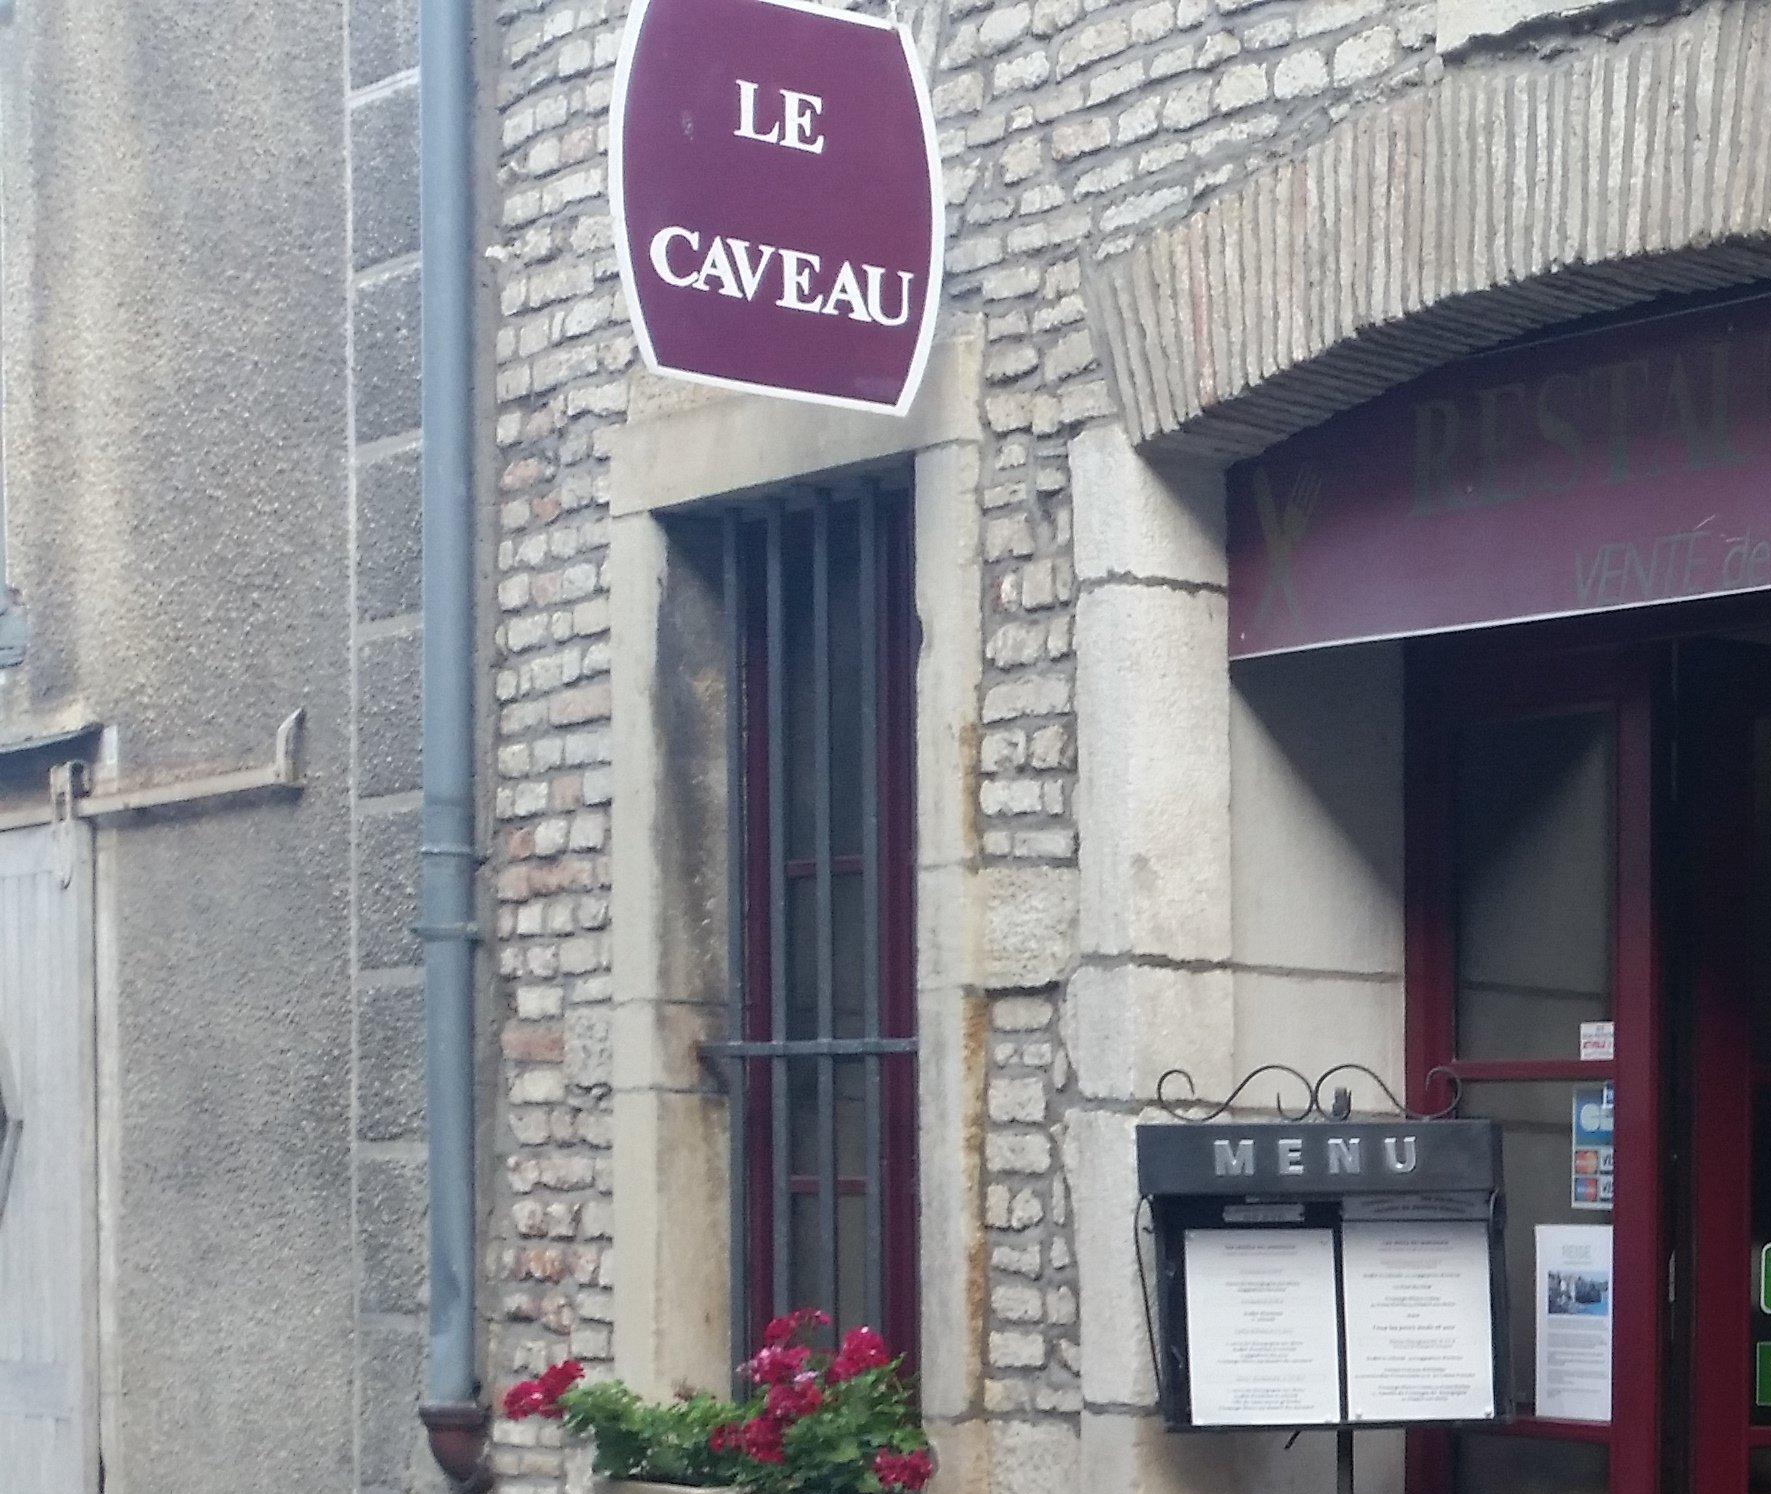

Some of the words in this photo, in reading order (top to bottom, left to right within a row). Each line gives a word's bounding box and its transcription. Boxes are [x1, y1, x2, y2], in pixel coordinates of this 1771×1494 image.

[734, 79, 824, 154] LE
[649, 226, 914, 326] CAVEAU
[1574, 531, 1710, 606] VENTE
[1721, 527, 1771, 588] de
[1213, 1136, 1417, 1176] MENU
